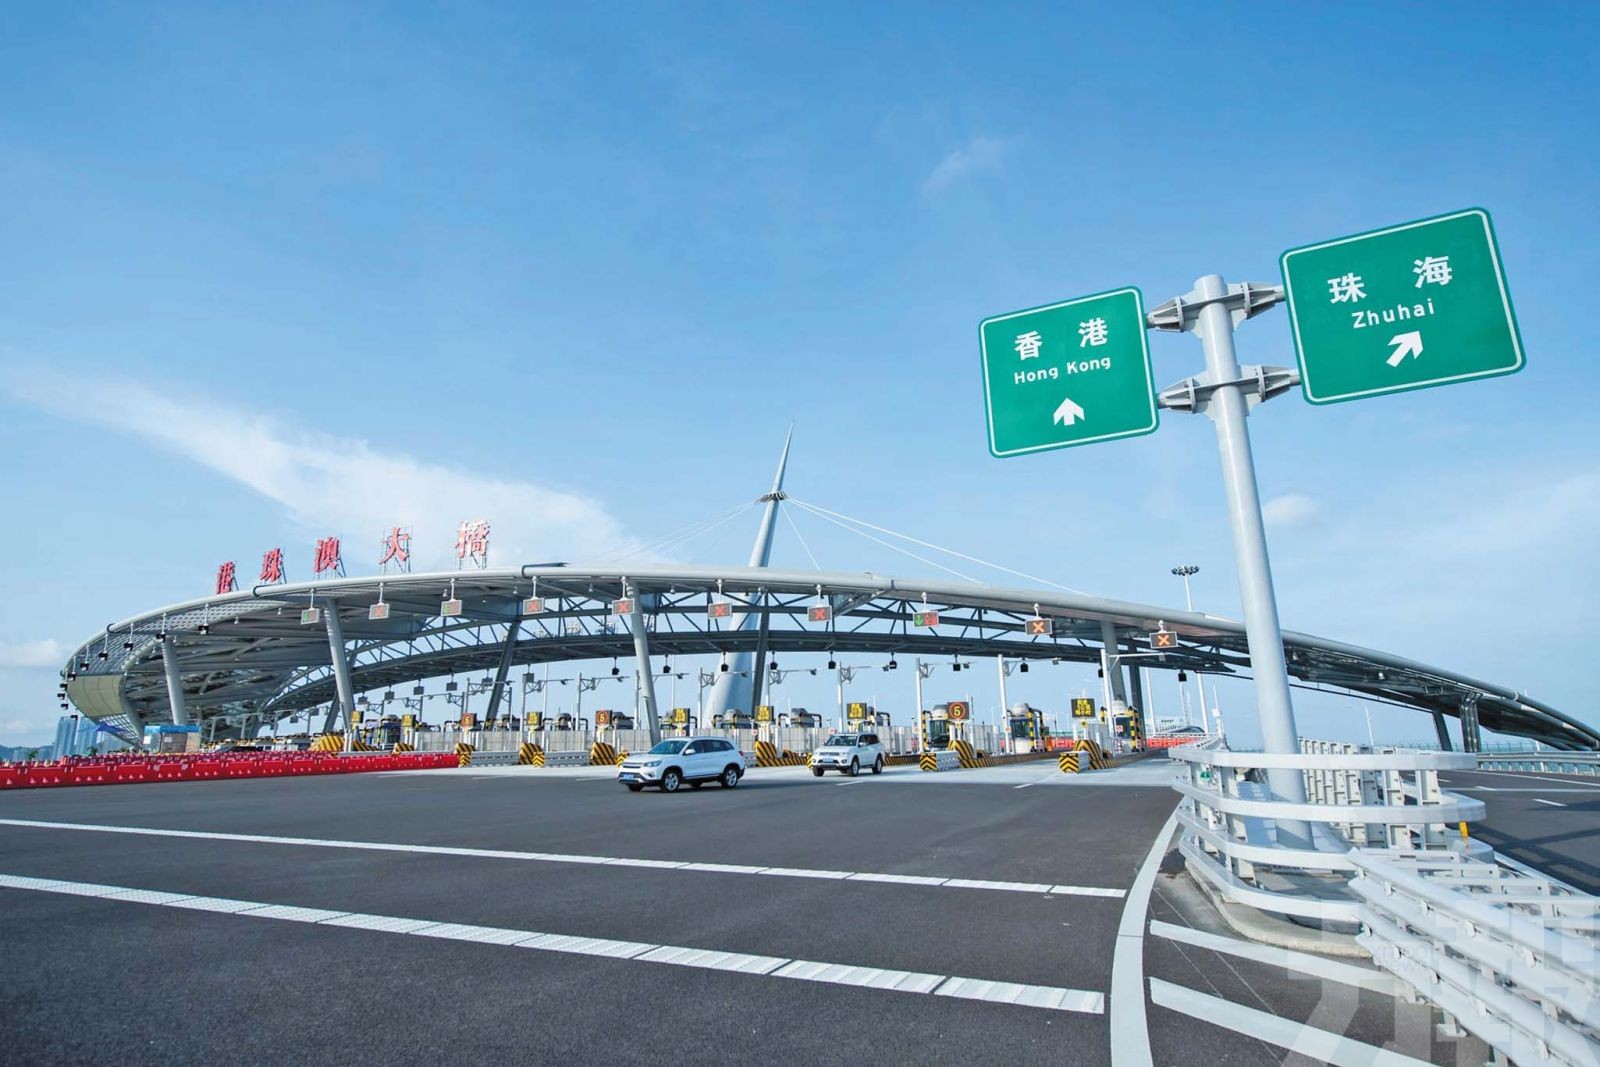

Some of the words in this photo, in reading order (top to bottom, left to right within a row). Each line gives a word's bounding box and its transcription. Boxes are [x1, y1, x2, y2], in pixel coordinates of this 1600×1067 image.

[1328, 255, 1453, 304] 珠海
[1352, 298, 1435, 330] Zhuhai
[1014, 317, 1109, 361] 香港
[1014, 364, 1059, 385] Hong
[1066, 354, 1112, 376] Kong
